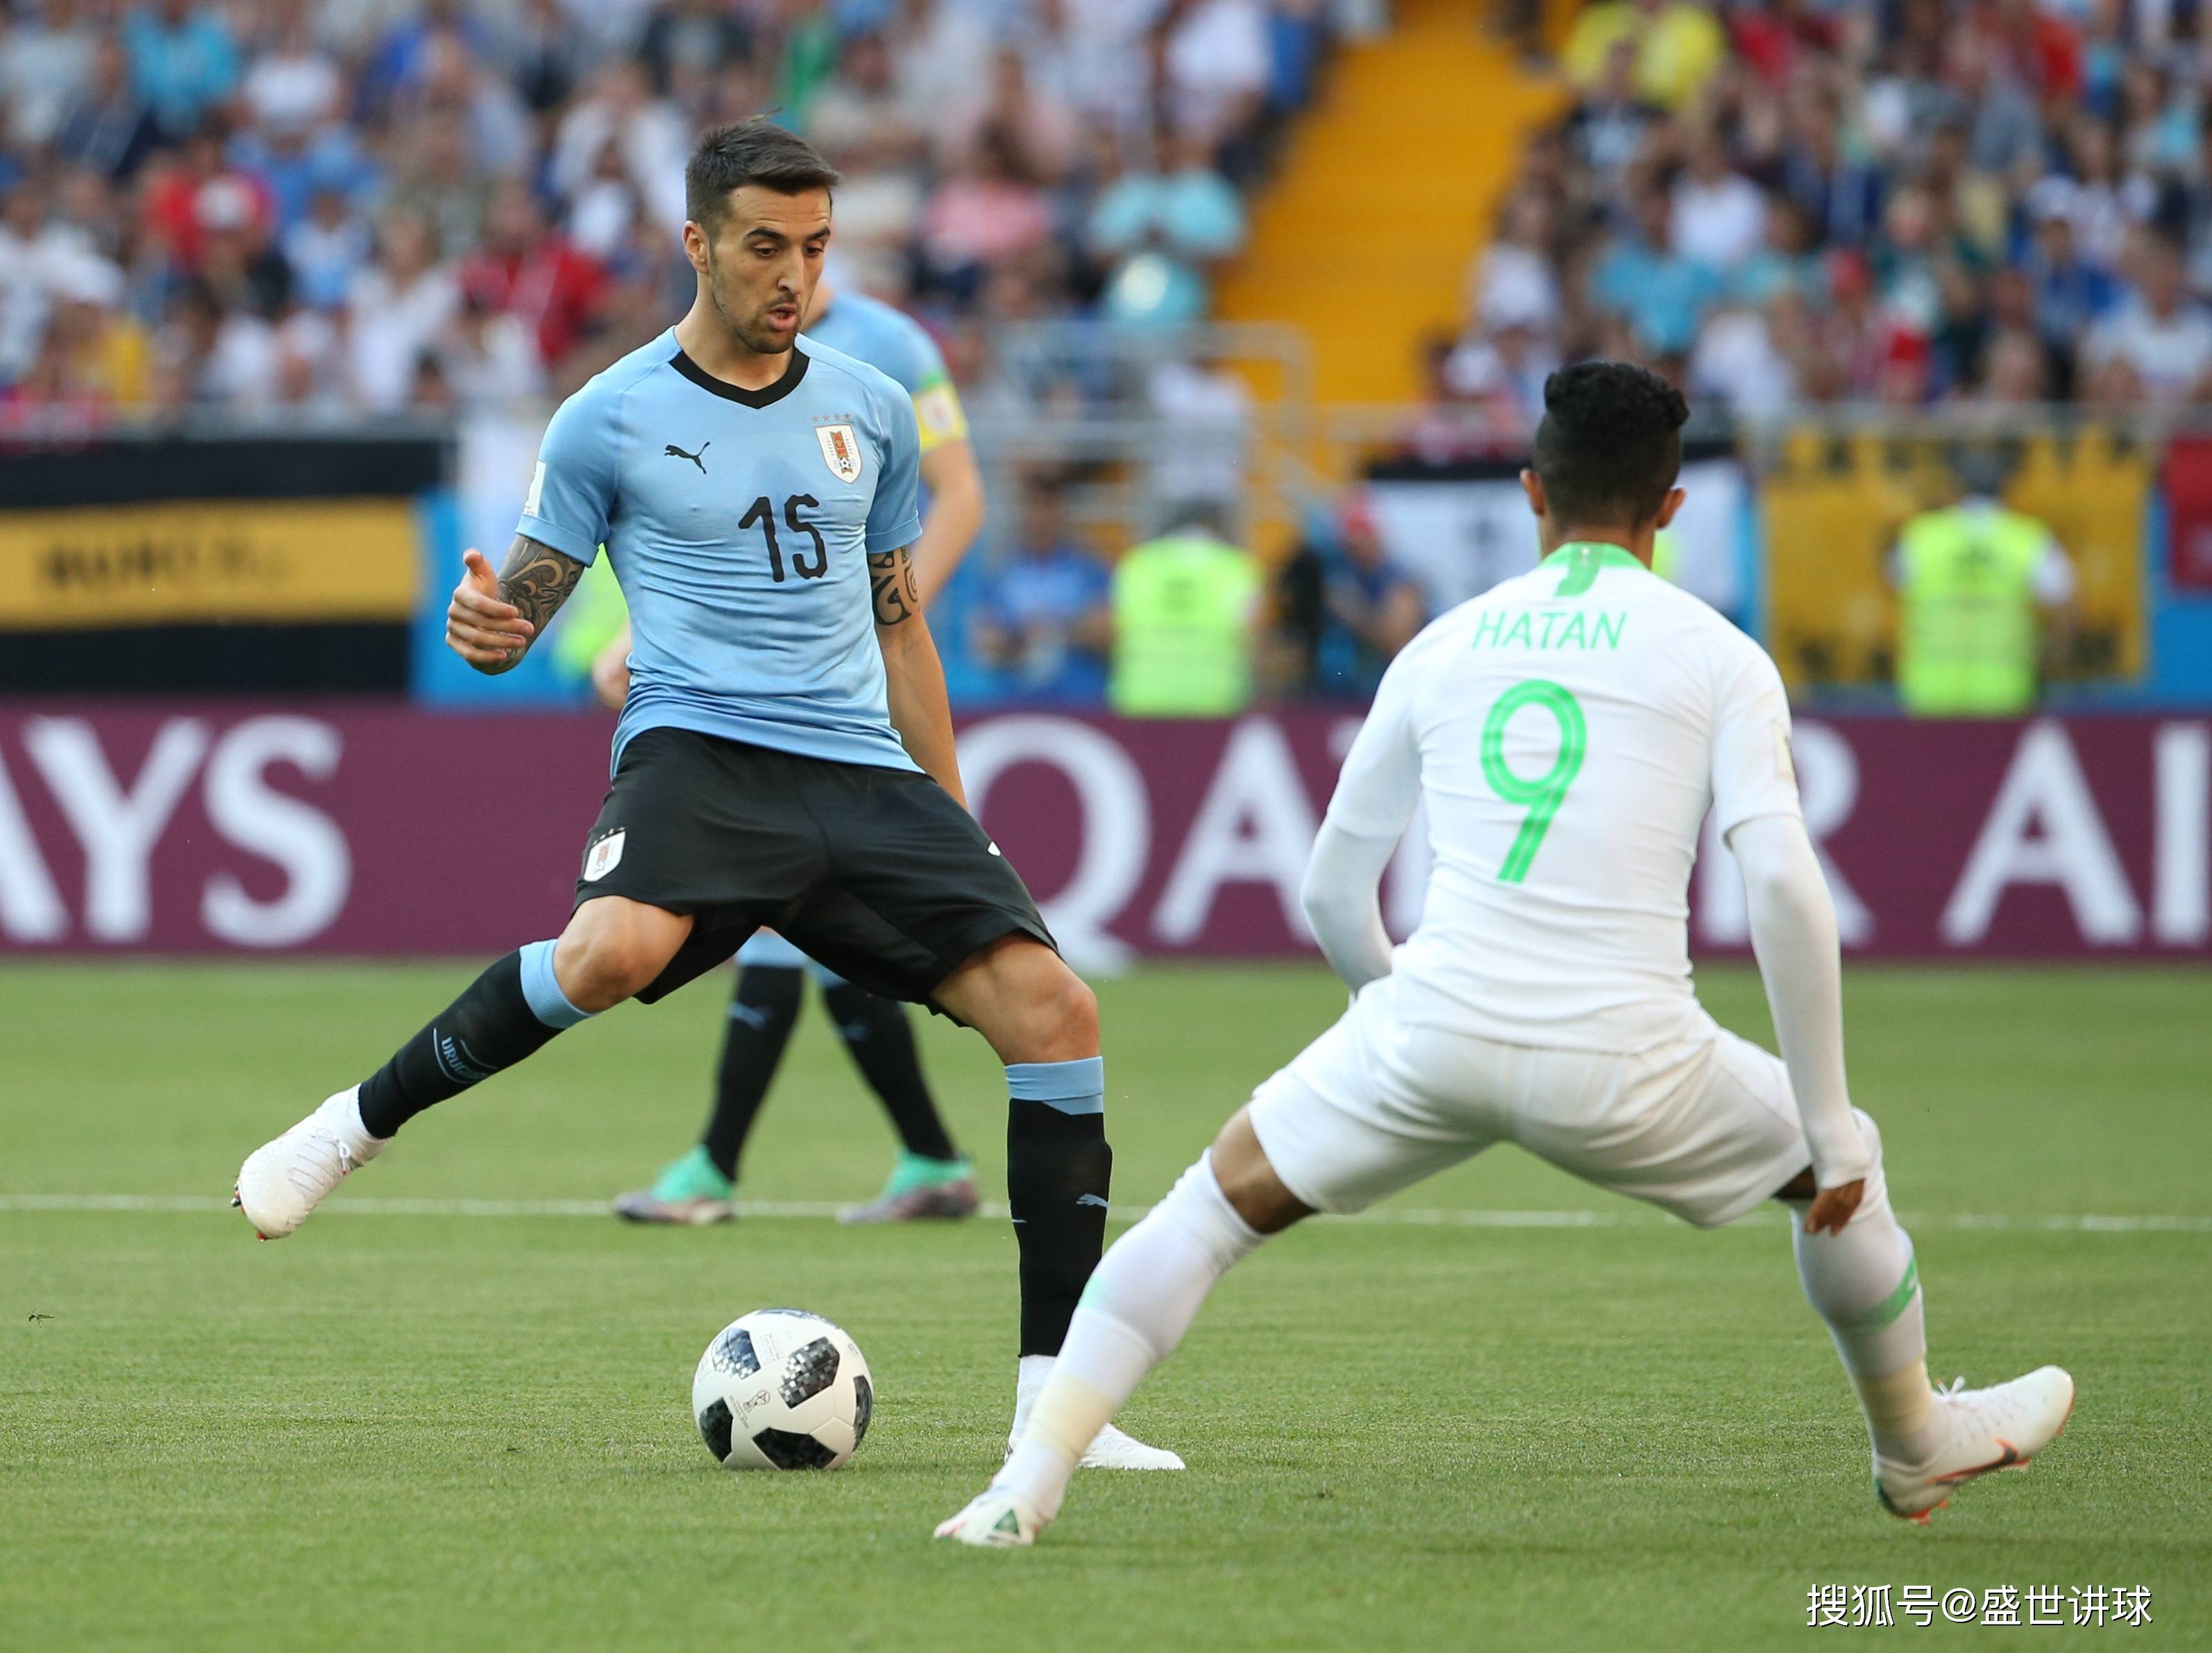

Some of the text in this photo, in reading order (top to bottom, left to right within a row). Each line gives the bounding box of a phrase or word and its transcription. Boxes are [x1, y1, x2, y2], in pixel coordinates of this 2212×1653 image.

[738, 494, 828, 582] 15
[1472, 612, 1627, 650] HATAN
[956, 714, 1875, 973] QAR
[1480, 678, 1587, 884] 9
